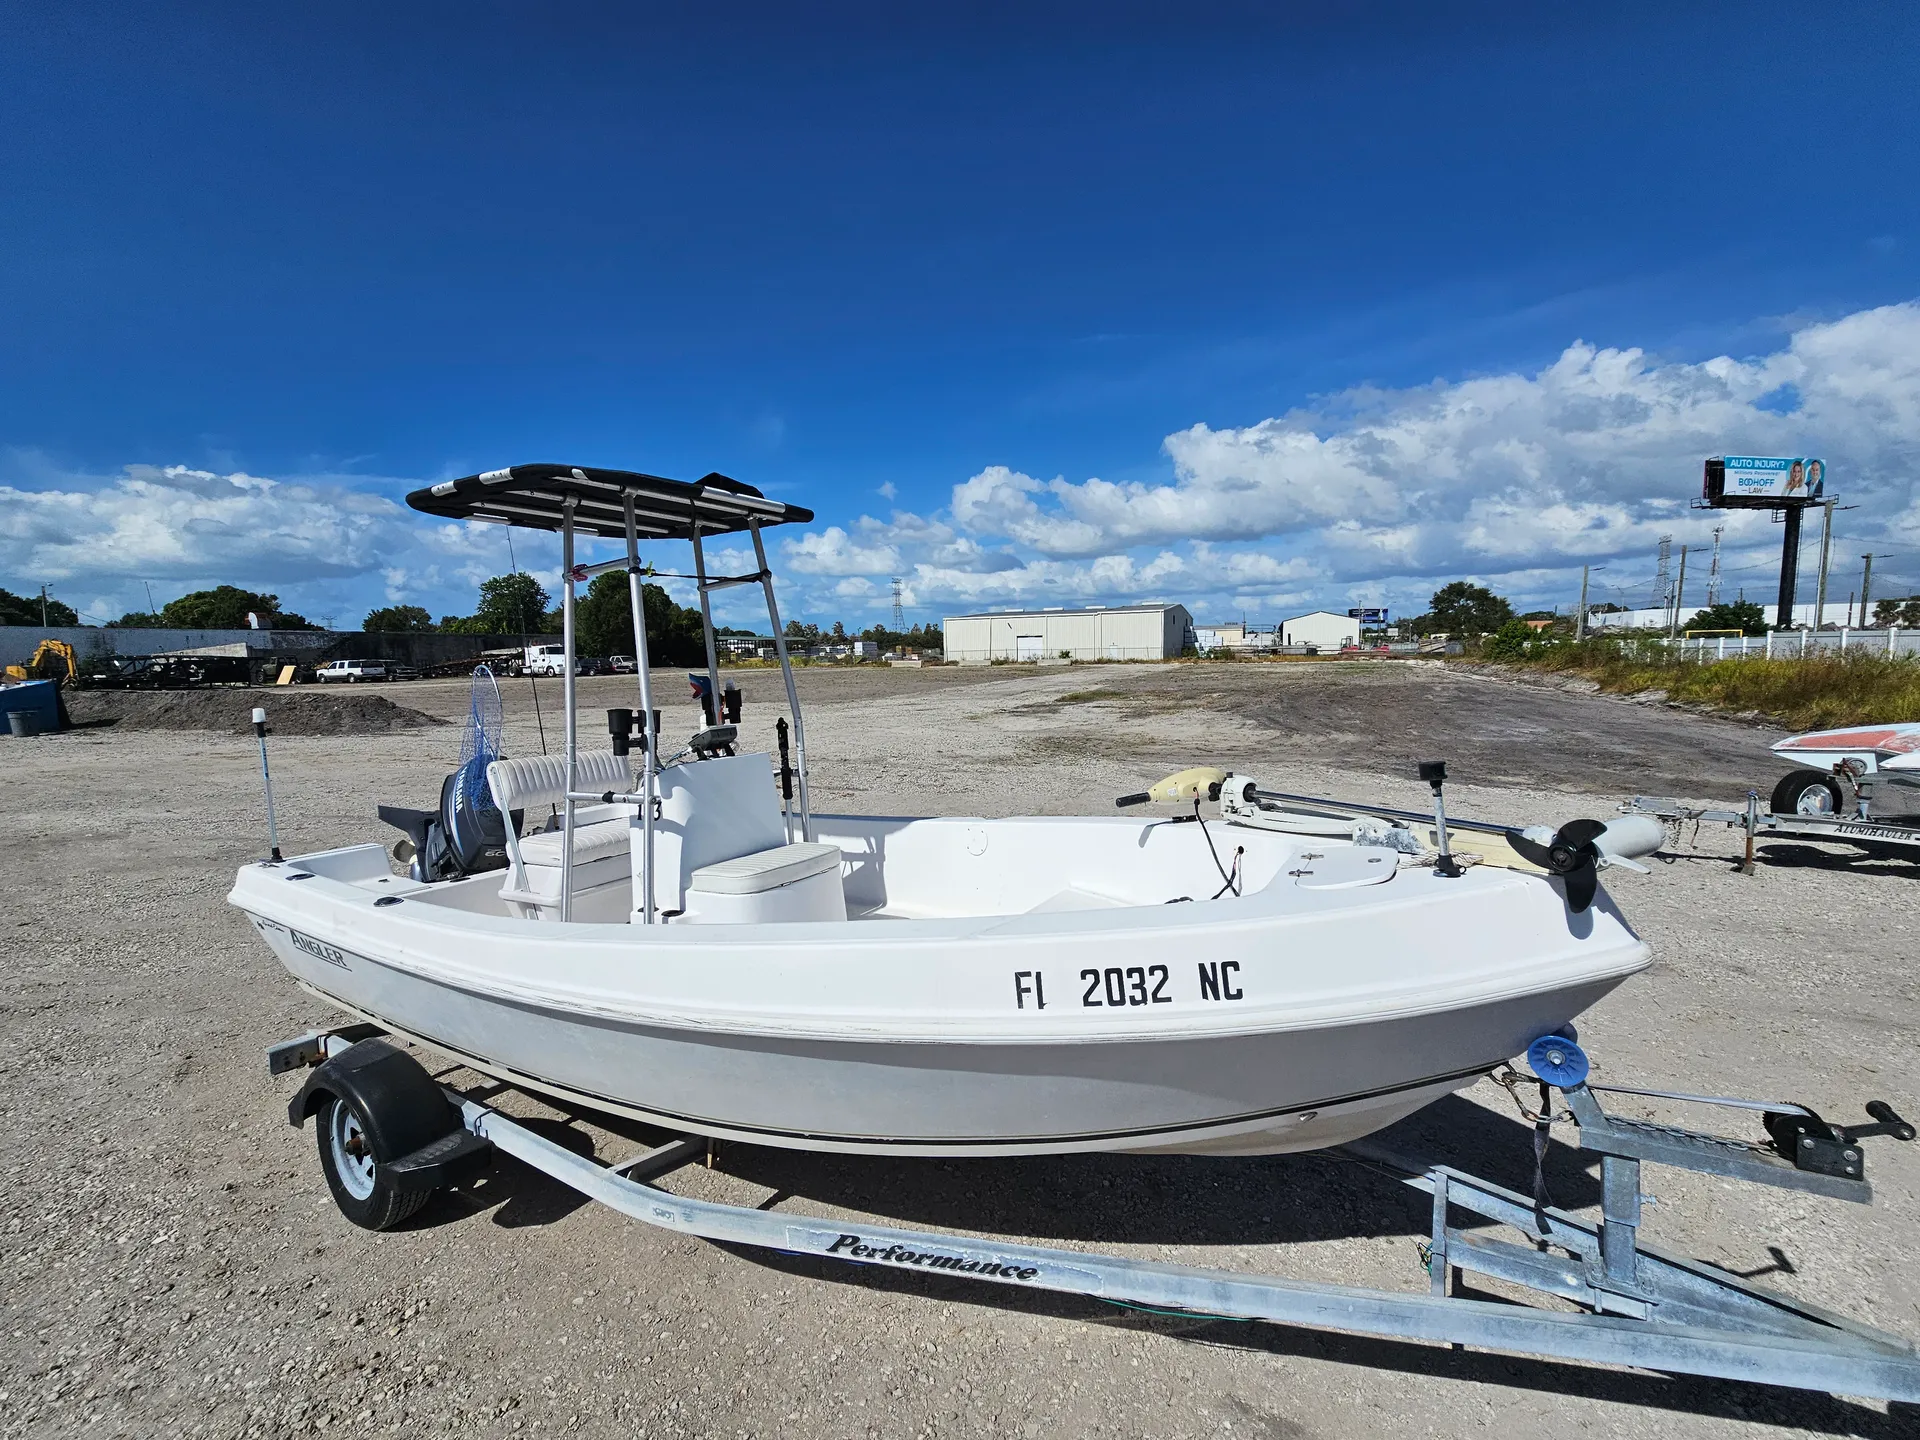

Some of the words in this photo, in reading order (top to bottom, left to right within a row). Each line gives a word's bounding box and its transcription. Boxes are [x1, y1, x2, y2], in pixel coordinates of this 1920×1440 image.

[1730, 459, 1753, 468] AUTO
[1754, 460, 1785, 469] INJURY?
[1738, 477, 1776, 487] BOOHOFF
[455, 766, 467, 813] YAMAHA
[1834, 824, 1912, 840] ALUMIHAULER
[290, 929, 347, 967] ANGLER
[1080, 964, 1173, 1007] 2032
[1198, 961, 1244, 1001] NC
[825, 1234, 1039, 1282] Performance
